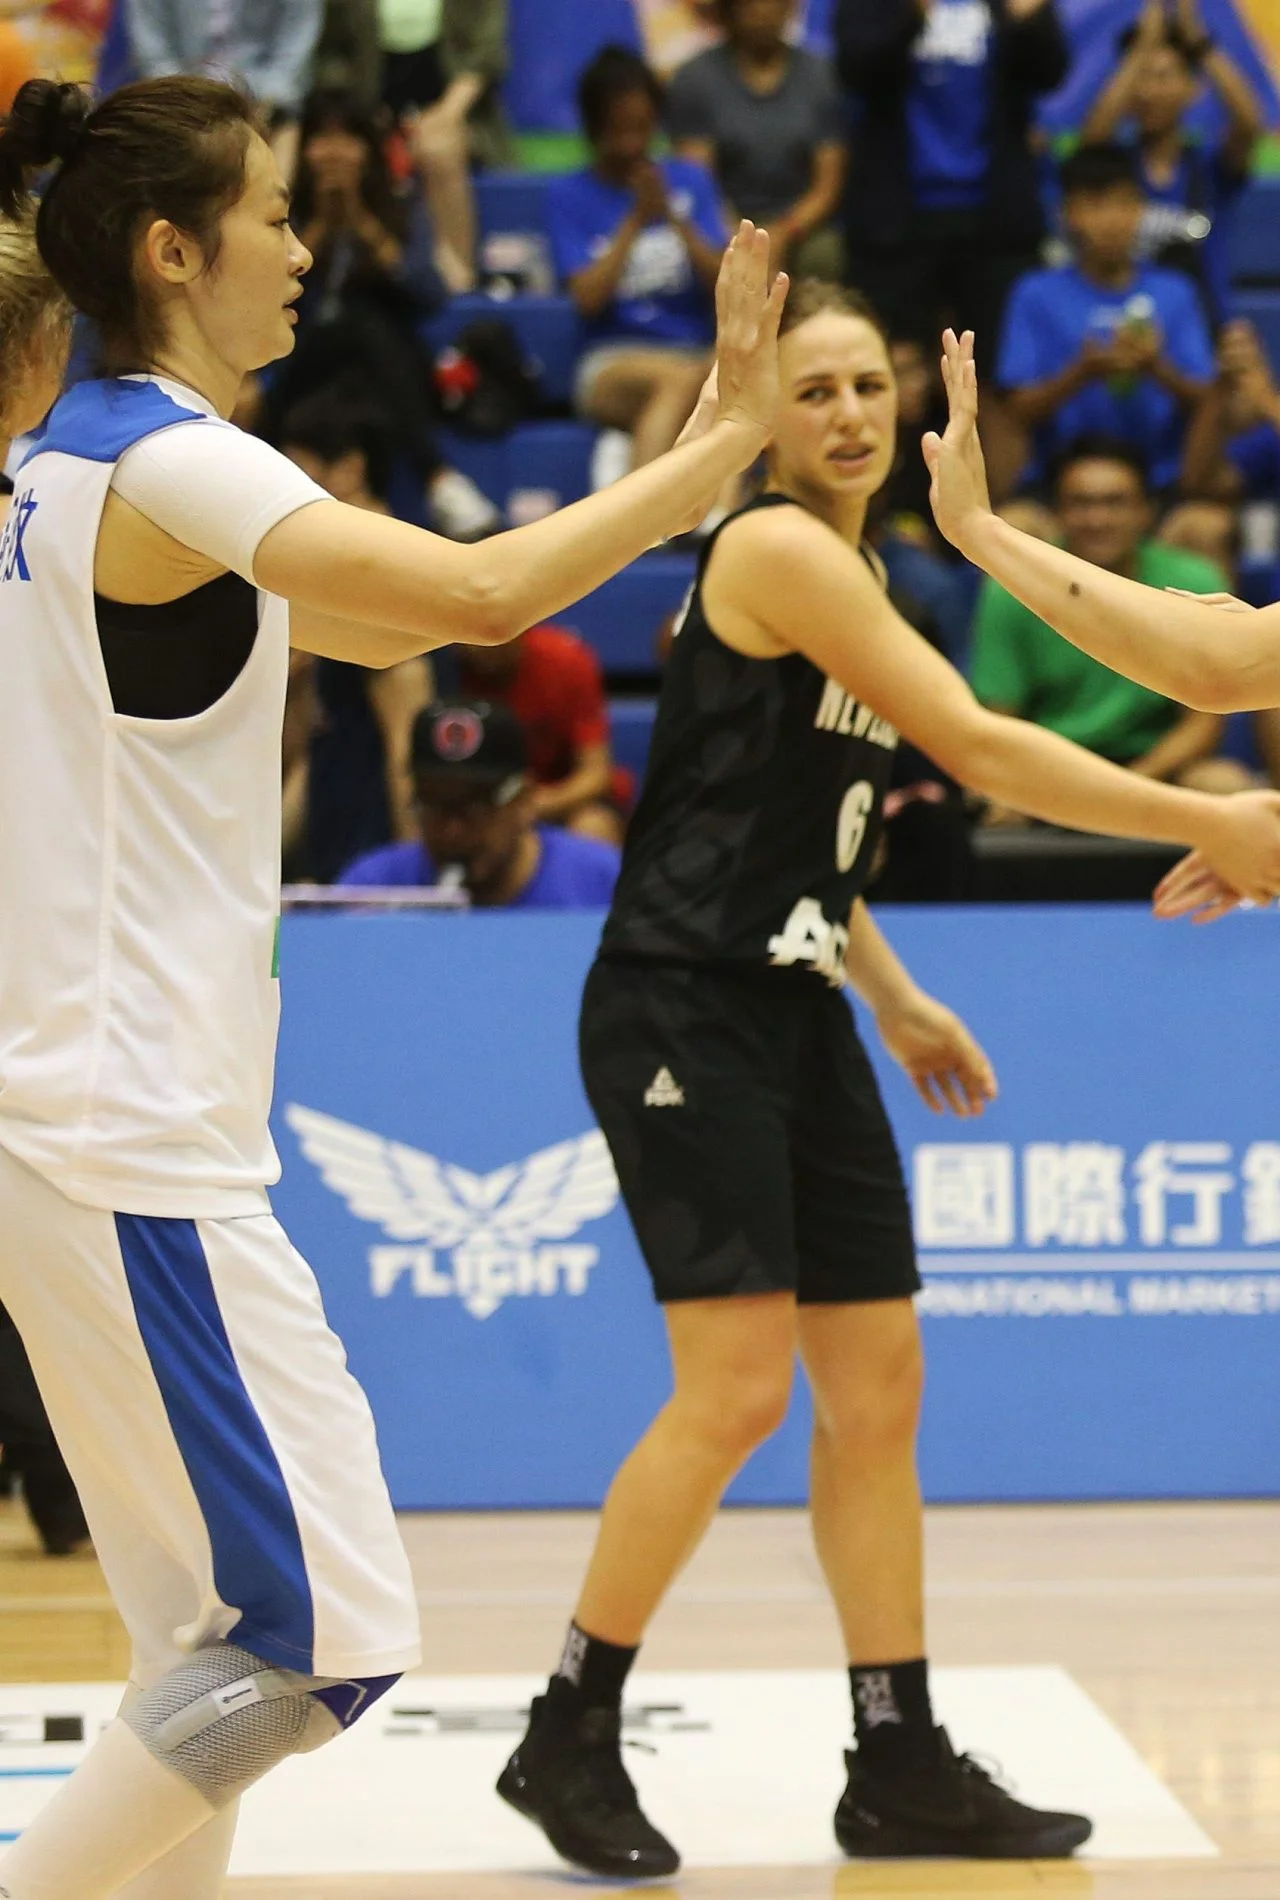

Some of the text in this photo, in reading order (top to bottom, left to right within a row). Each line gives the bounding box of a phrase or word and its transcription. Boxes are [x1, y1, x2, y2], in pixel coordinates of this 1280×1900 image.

[836, 780, 874, 873] 6
[368, 1243, 600, 1298] FLIGHT
[914, 1276, 1122, 1318] RNATIONAL
